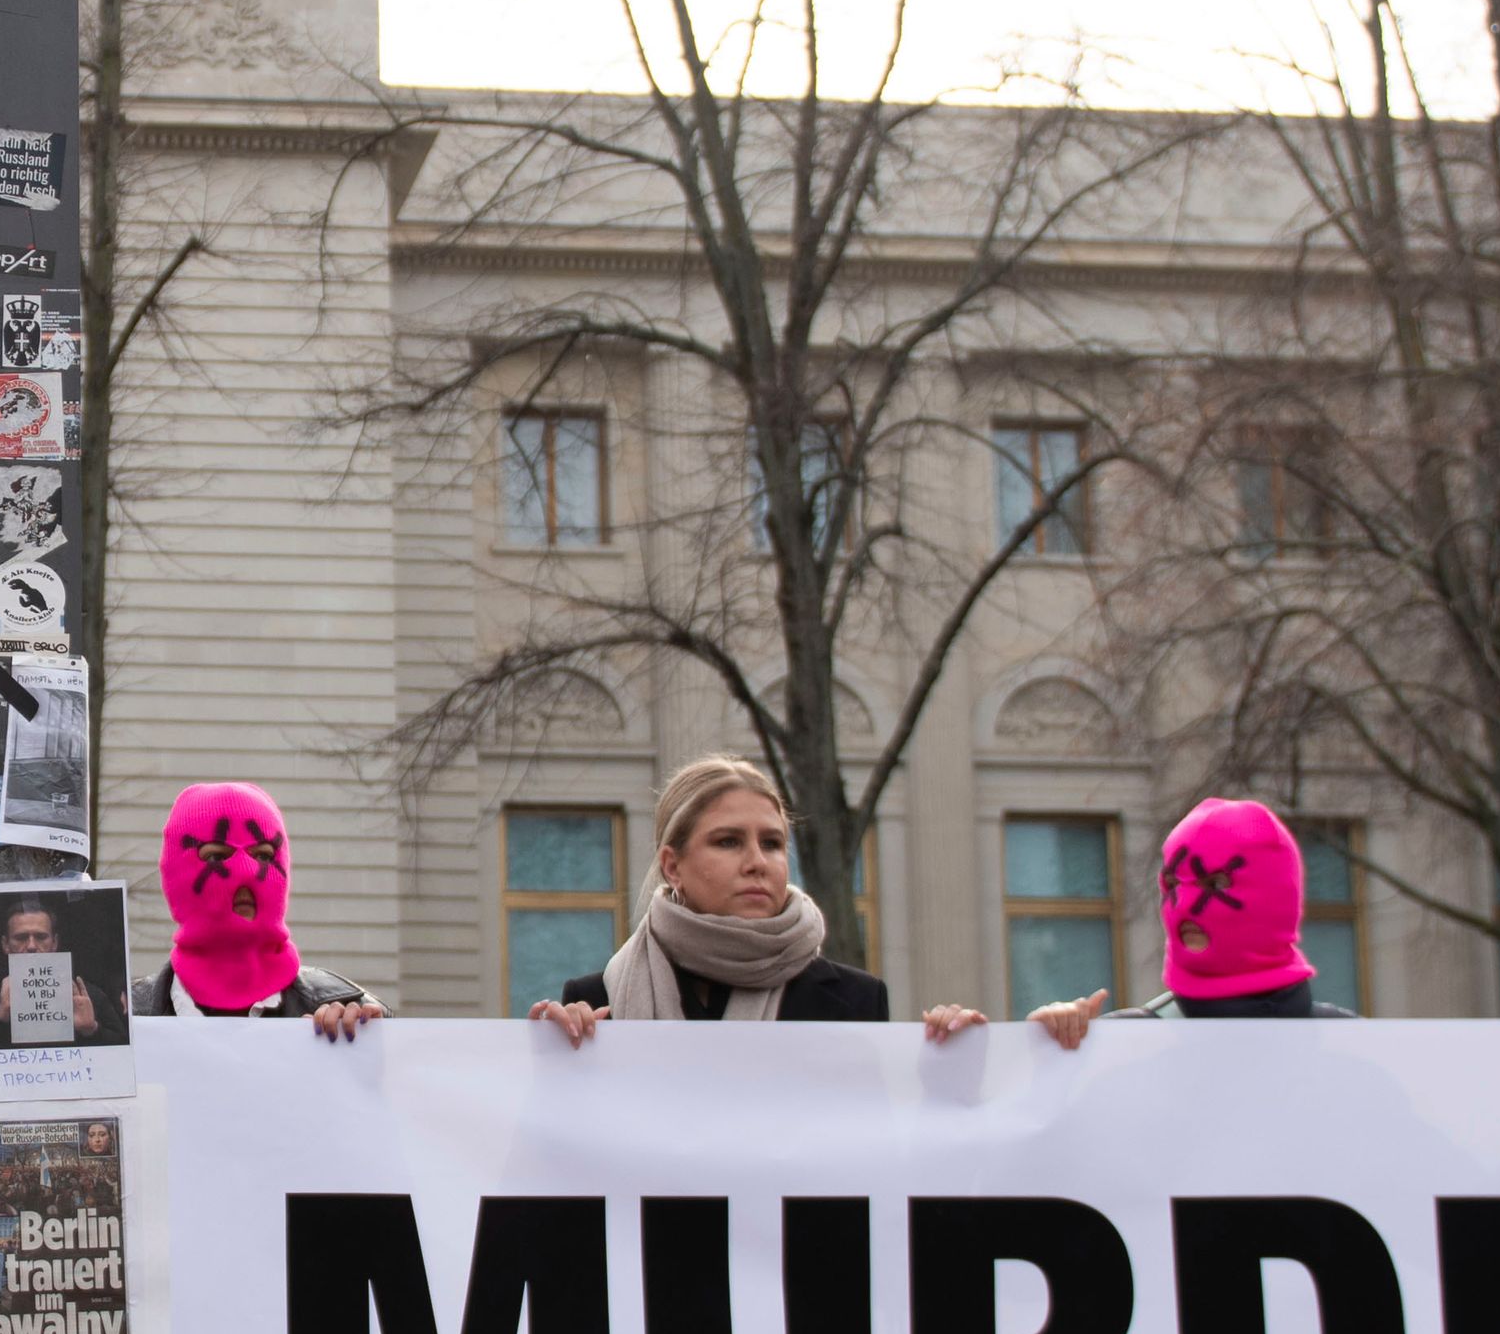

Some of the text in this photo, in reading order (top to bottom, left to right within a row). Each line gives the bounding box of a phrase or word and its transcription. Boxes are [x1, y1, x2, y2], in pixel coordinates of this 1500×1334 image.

[11, 167, 50, 185] richtig
[23, 182, 56, 198] Arsch
[28, 966, 53, 977] Я НЕ
[22, 977, 60, 988] БОЮСЬ
[27, 989, 56, 999] И ВЫ
[35, 1000, 49, 1010] НЕ
[3, 1067, 92, 1086] ПРОСТИМ!
[0, 1123, 78, 1135] Tausende protestieren
[20, 1207, 120, 1251] Berlin
[5, 1250, 122, 1293] trauert
[35, 1292, 63, 1311] um
